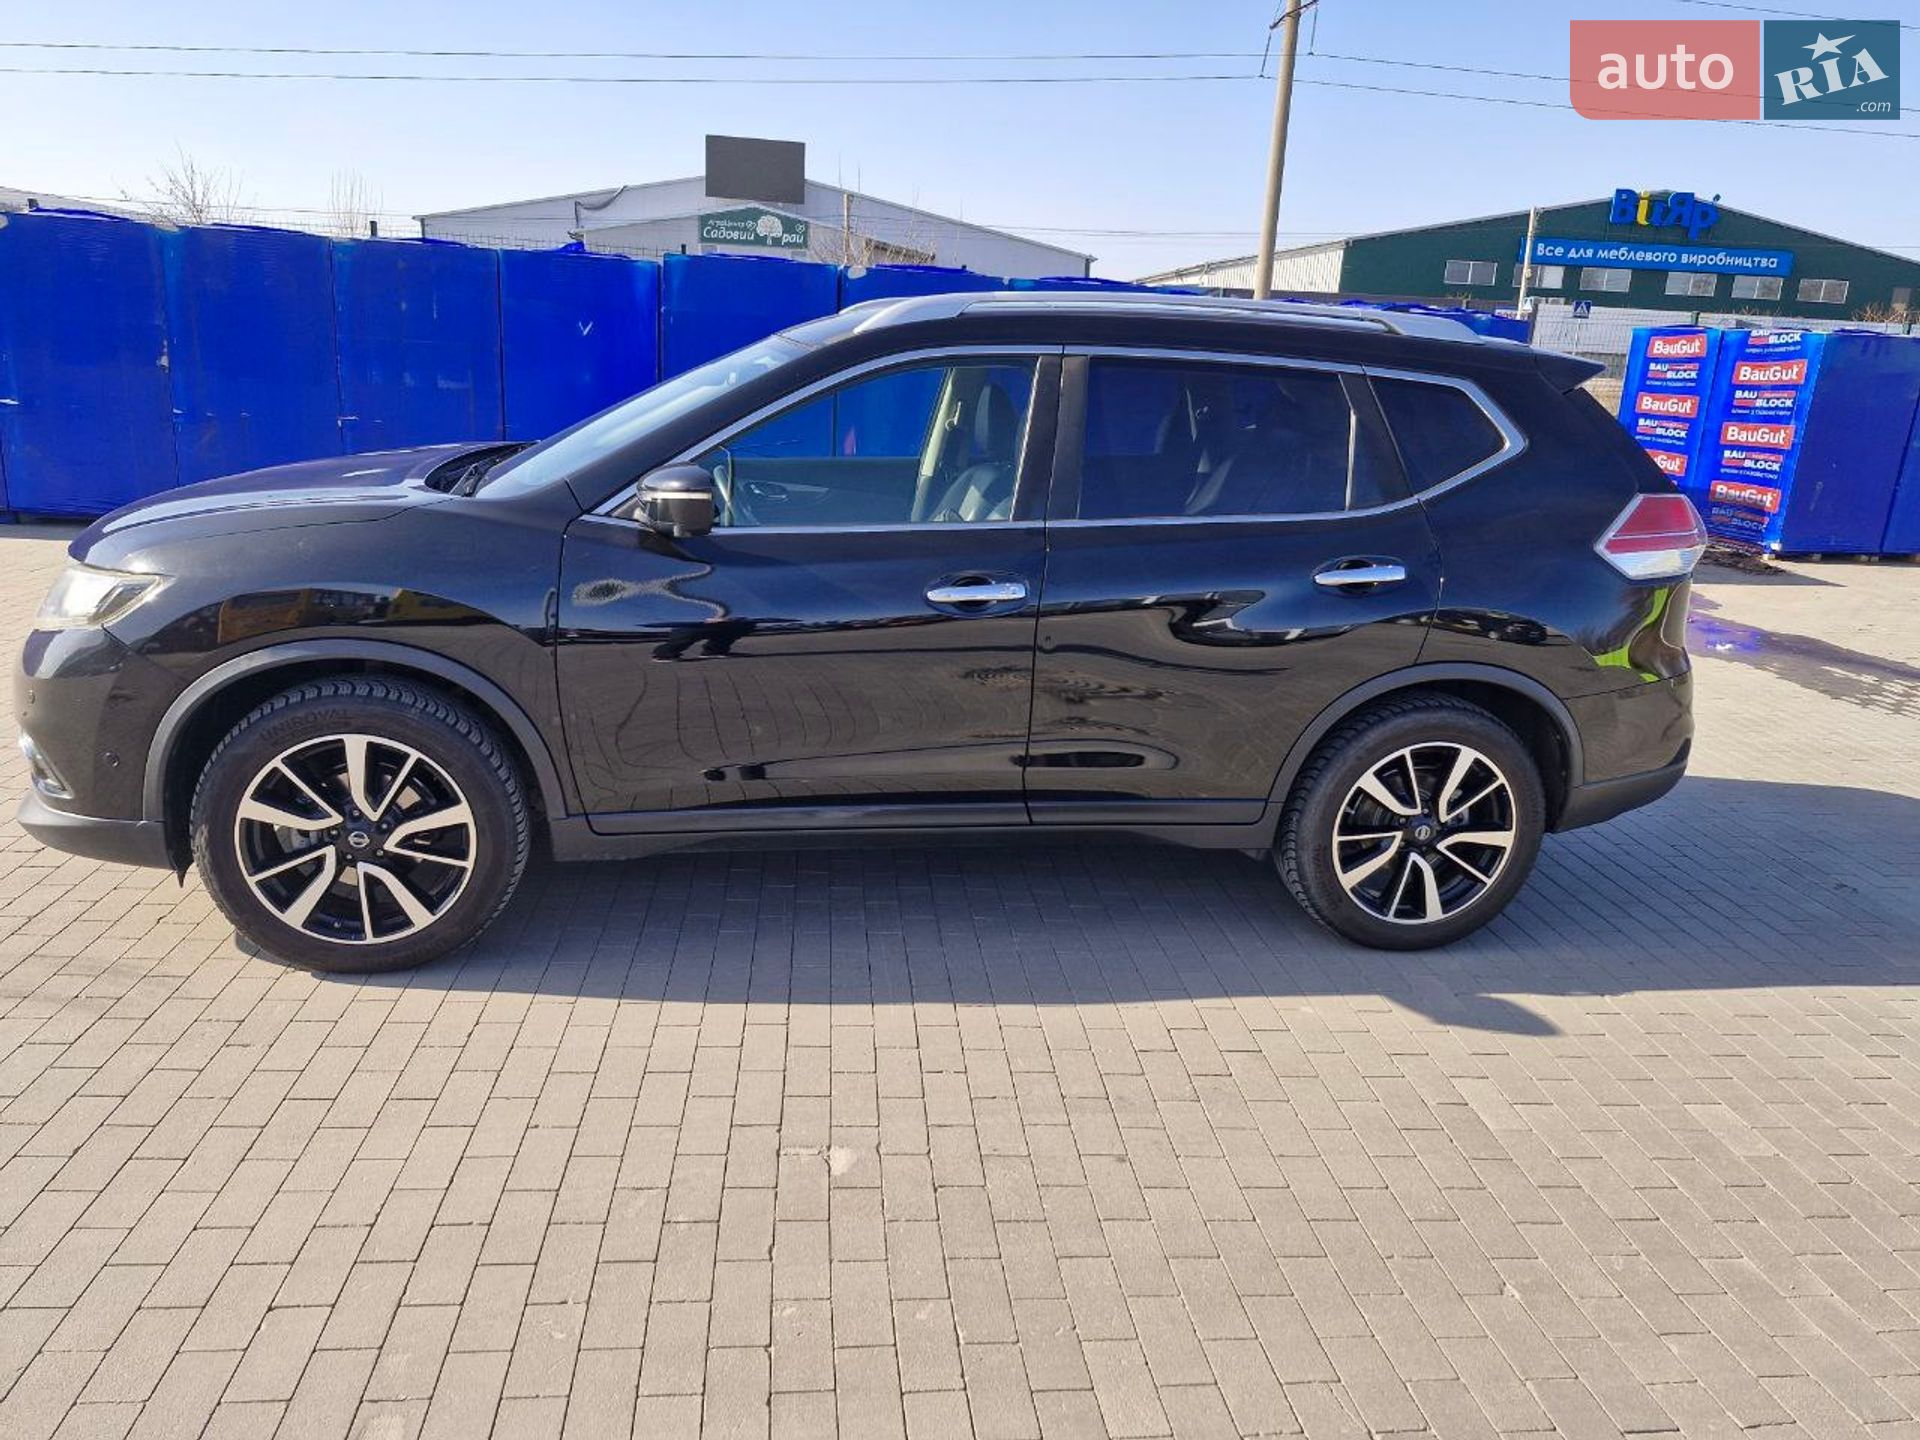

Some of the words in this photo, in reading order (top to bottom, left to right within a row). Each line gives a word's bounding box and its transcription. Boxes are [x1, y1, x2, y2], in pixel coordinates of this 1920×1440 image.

[1536, 243, 1564, 257] Все
[1568, 247, 1593, 259] для
[1597, 247, 1677, 263] меблевого
[1681, 251, 1778, 269] виробництва
[1768, 333, 1801, 344] BLOCK
[1653, 338, 1701, 354] BauGut
[1649, 362, 1668, 371] BAU
[1738, 363, 1800, 381] BauGut
[1666, 370, 1697, 379] BLOCK
[1734, 390, 1758, 399] BAU
[1641, 396, 1692, 414] BauGut
[1755, 398, 1794, 408] BLOCK
[1638, 418, 1658, 427] BAU
[1656, 426, 1688, 438] BLOCK
[1726, 425, 1787, 445] BauGut
[1723, 449, 1746, 459] BAU
[1654, 454, 1681, 472] Gut
[1744, 459, 1781, 472] BLOCK
[1714, 484, 1774, 508] BauGut
